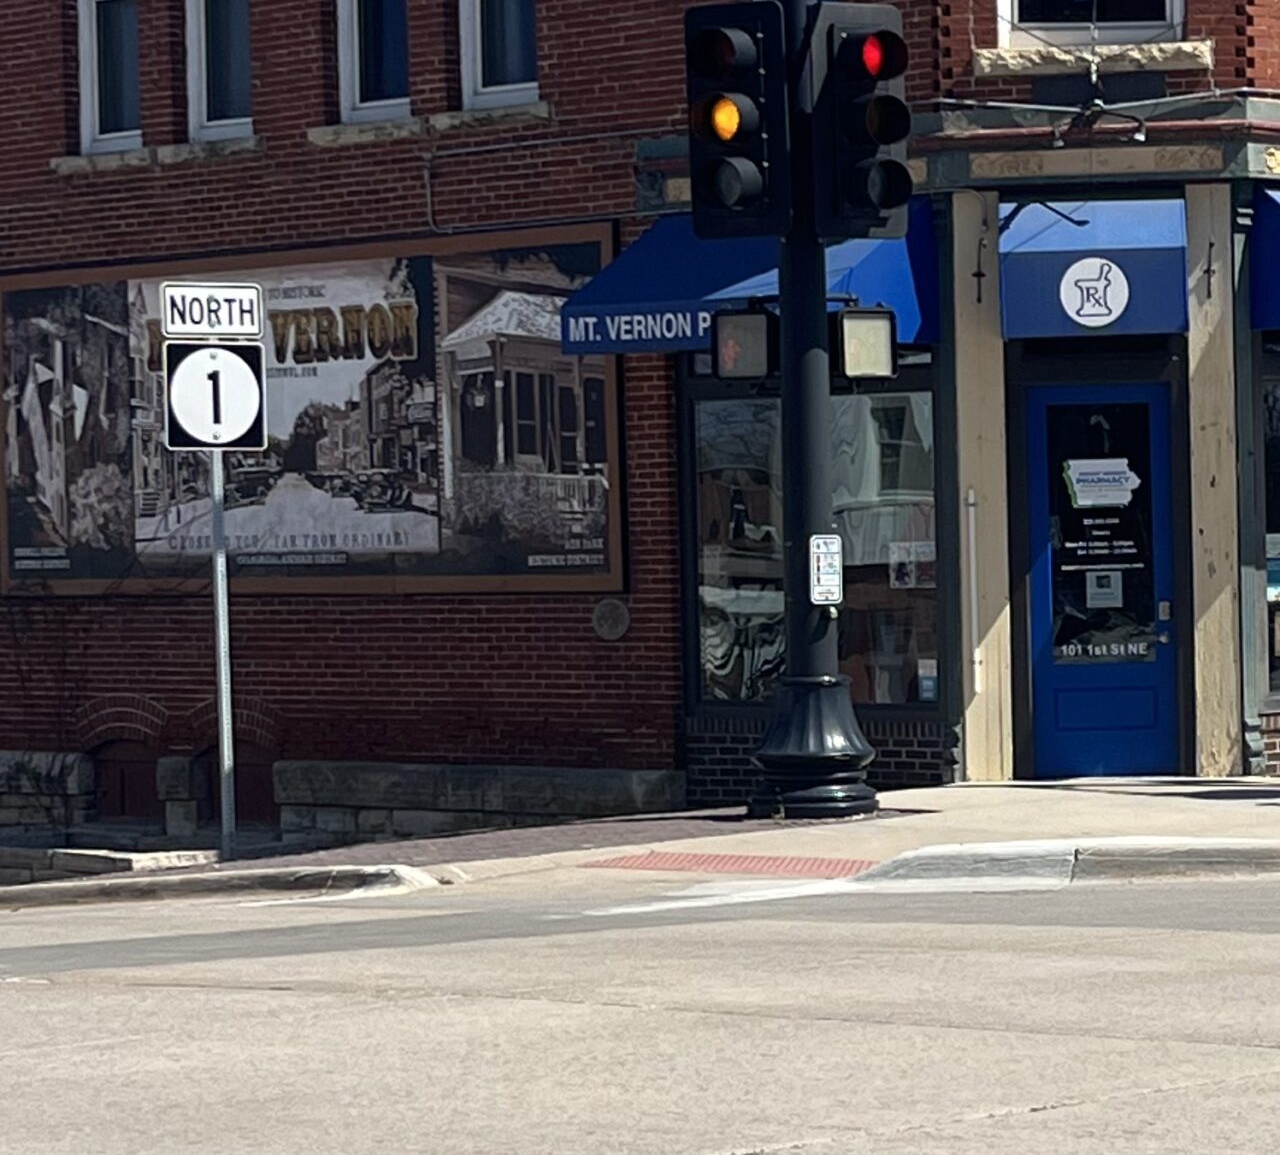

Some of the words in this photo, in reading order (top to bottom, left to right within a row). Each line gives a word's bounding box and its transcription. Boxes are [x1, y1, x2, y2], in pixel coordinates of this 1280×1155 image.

[169, 294, 255, 327] NORTH
[568, 316, 601, 342] MT.
[605, 312, 692, 341] VERNON
[268, 301, 418, 364] VERNON
[206, 370, 222, 425] 1
[1060, 644, 1082, 656] 101
[1128, 642, 1148, 655] NE
